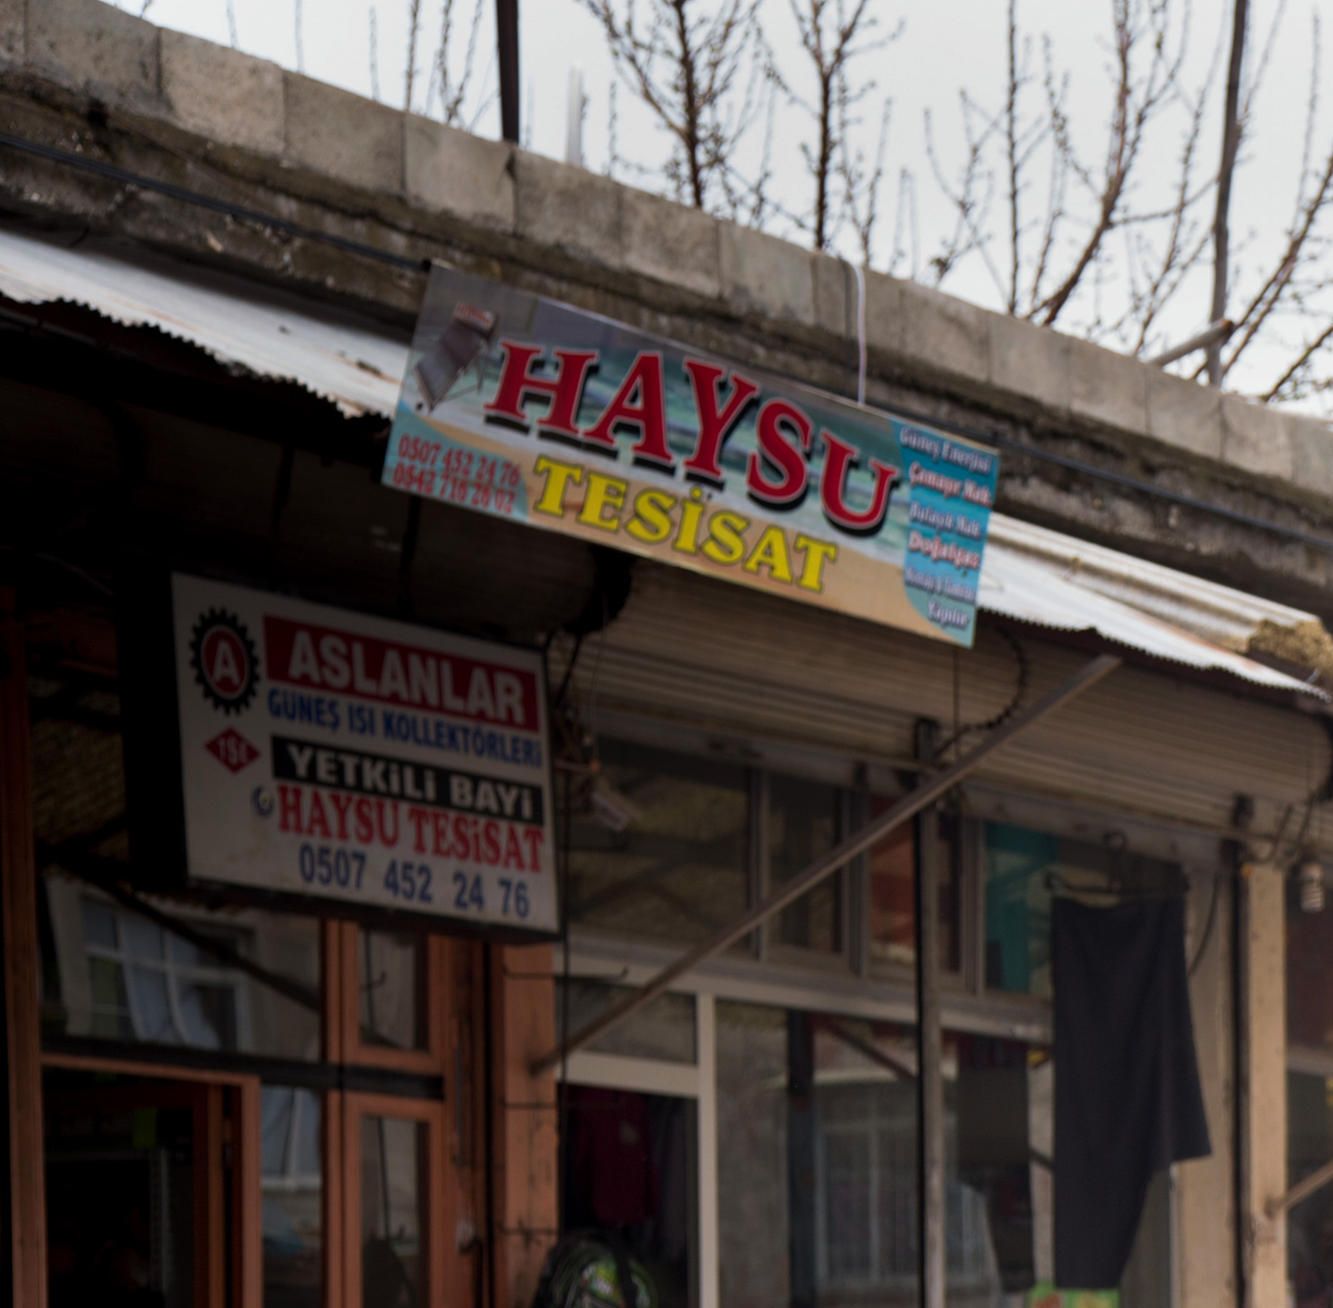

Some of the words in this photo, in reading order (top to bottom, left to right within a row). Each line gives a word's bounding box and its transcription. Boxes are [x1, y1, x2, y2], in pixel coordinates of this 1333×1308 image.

[398, 433, 442, 467] 0507
[484, 340, 901, 532] HAYSU
[532, 456, 838, 594] TESİSAT
[288, 630, 527, 725] ASLANLAR
[287, 743, 437, 801] YETKİLİ
[449, 776, 534, 820] BAYİ
[278, 784, 399, 848] HAYSU
[407, 805, 544, 873] TESİSAT
[300, 845, 366, 889] 0507
[383, 858, 432, 904] 452
[453, 872, 485, 911] 24
[498, 879, 531, 919] 76
